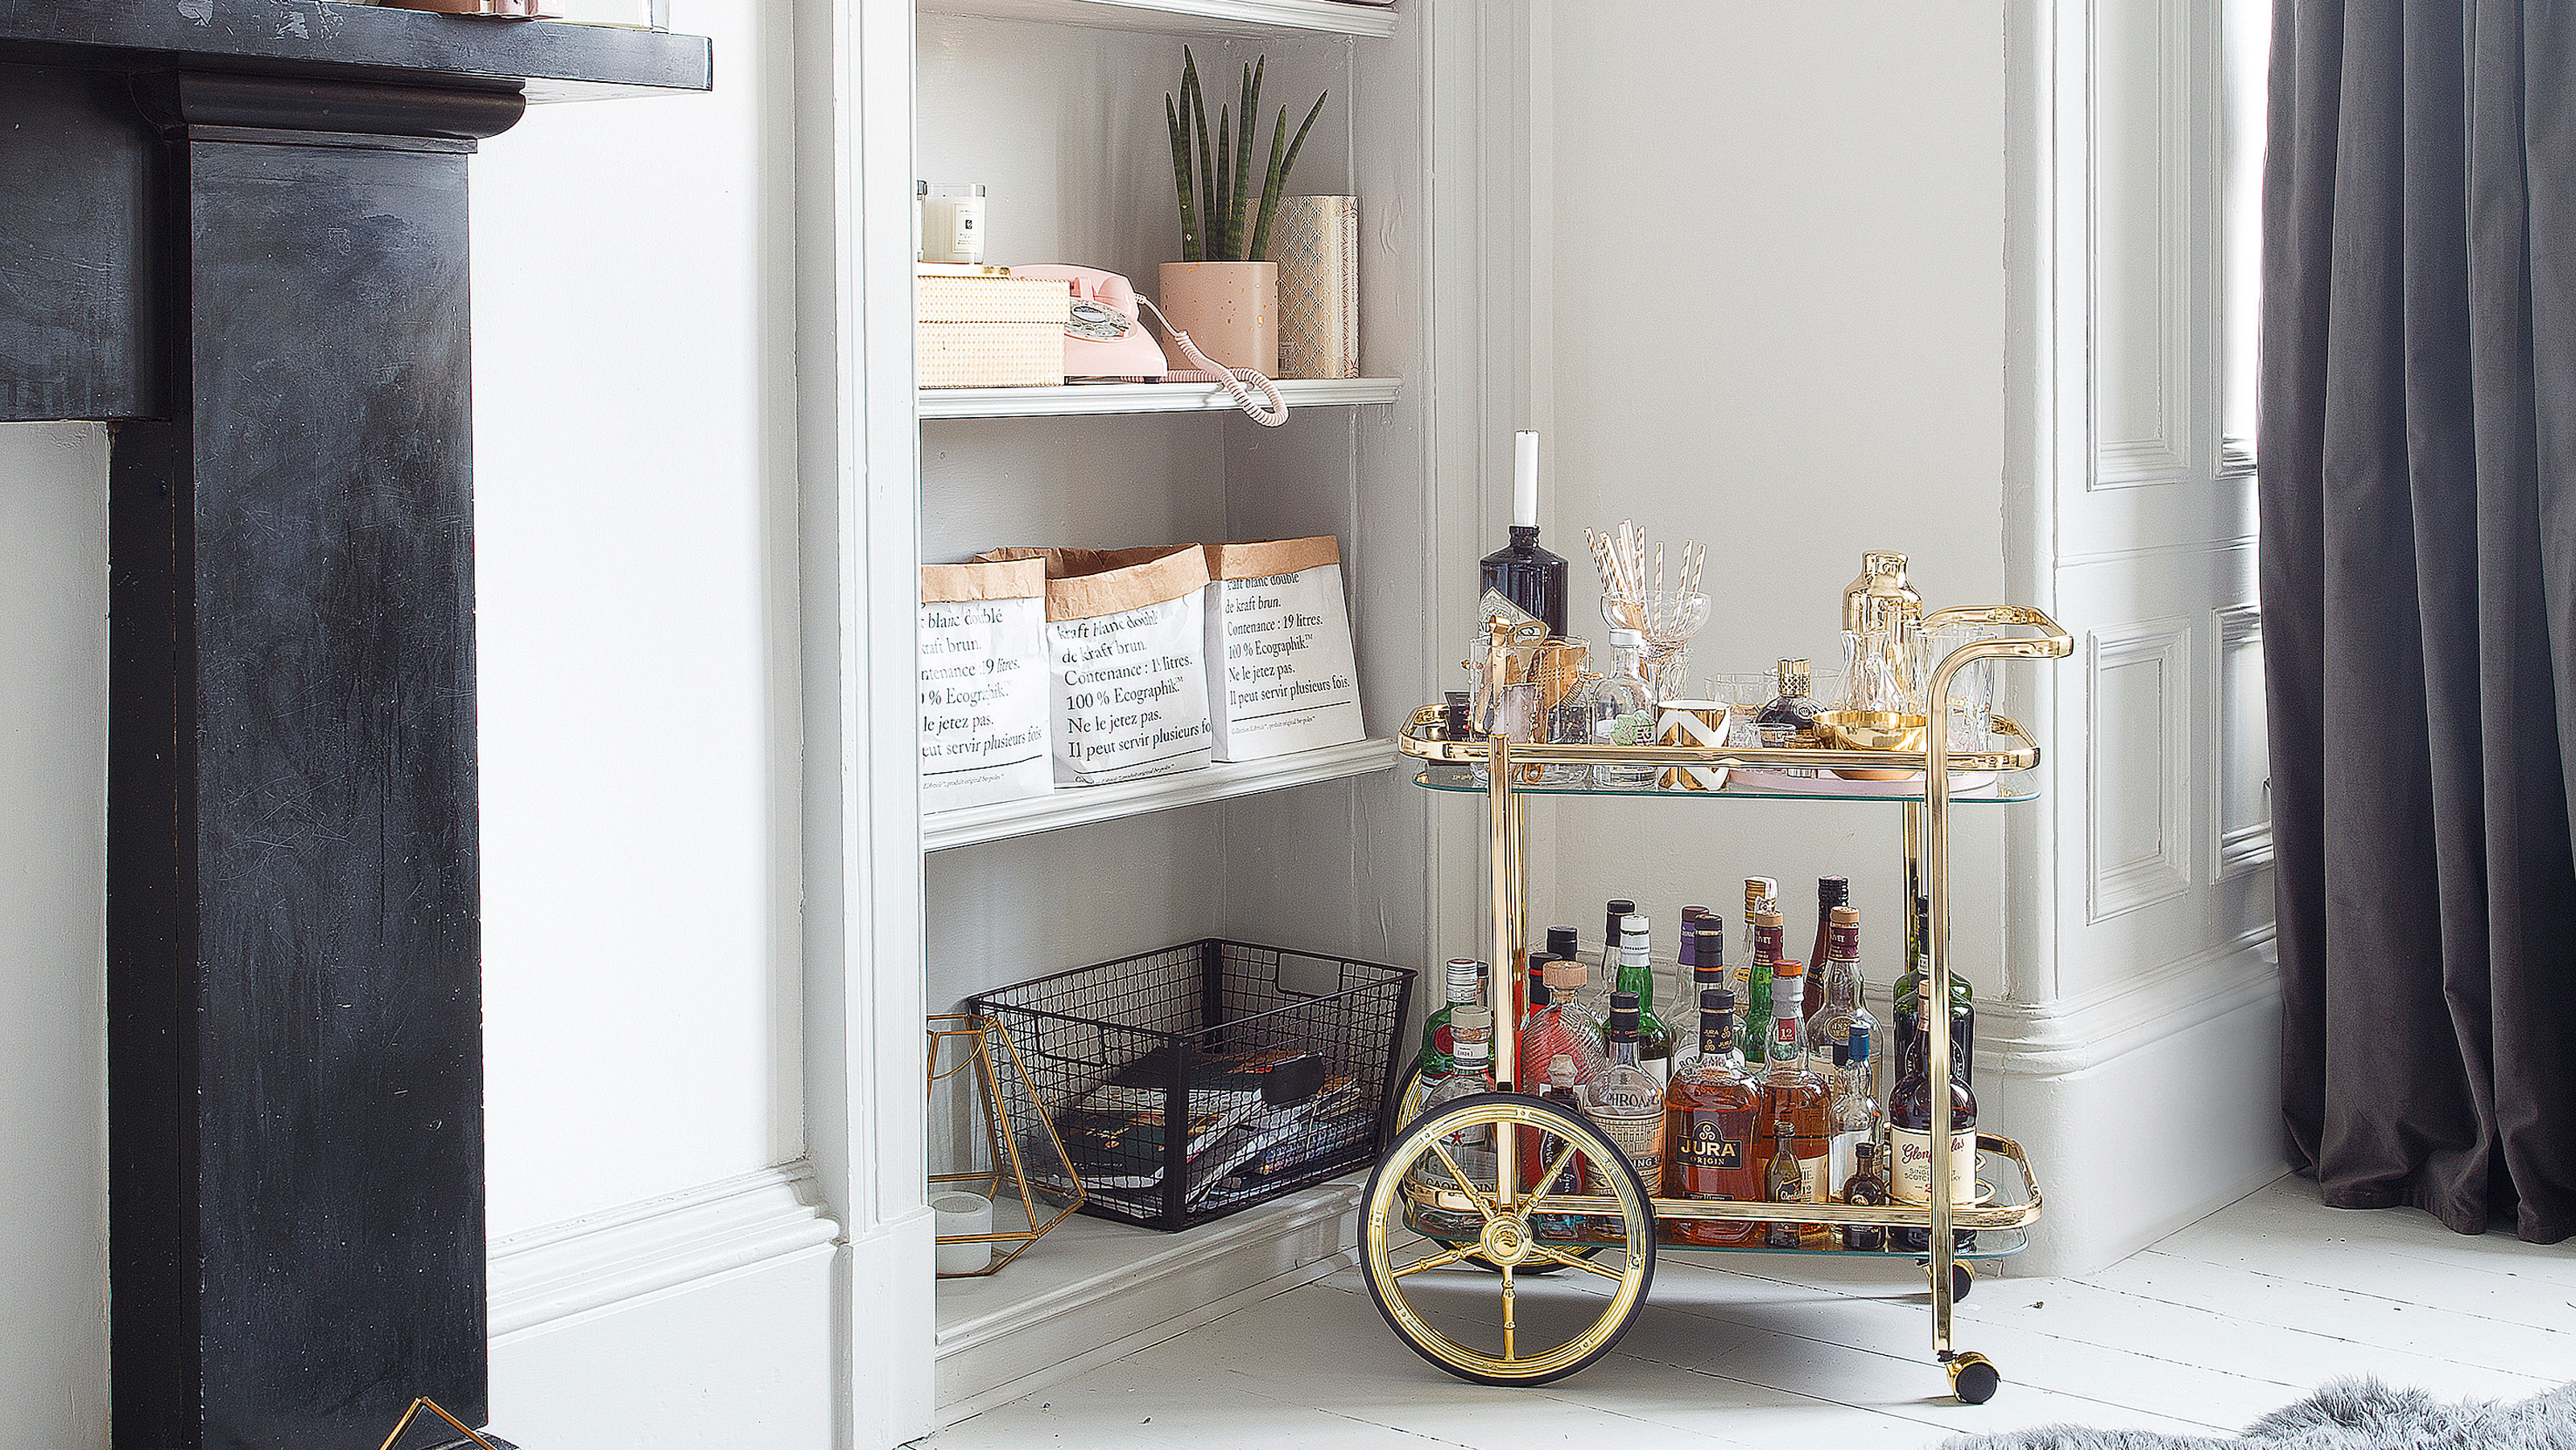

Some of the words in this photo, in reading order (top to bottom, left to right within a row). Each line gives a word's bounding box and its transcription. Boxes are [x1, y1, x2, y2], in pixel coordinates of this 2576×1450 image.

[1225, 599, 1234, 613] de
[1236, 595, 1256, 612] kraft
[1257, 595, 1282, 609] brun.
[928, 612, 960, 629] blanc
[1227, 619, 1276, 637] Contenance
[1283, 613, 1295, 630] 19
[1296, 613, 1324, 628] litres.
[946, 637, 982, 653] brun.
[1062, 648, 1078, 664] de
[1114, 639, 1148, 655] brun.
[1243, 641, 1254, 657] %
[921, 663, 976, 681] ntenance
[1064, 664, 1143, 687] Contenance
[1162, 654, 1194, 671] litres.
[1228, 666, 1241, 683] Ne
[1241, 665, 1251, 681] le
[1252, 665, 1276, 684] jetez
[1276, 662, 1296, 680] pas.
[928, 689, 943, 706] %
[1066, 692, 1094, 711] 100
[1096, 689, 1110, 707] %
[1238, 691, 1260, 709] peut
[1261, 683, 1289, 700] servir
[1290, 677, 1332, 701] plusieurs
[1331, 674, 1352, 690] fois.
[923, 715, 935, 733] le
[936, 715, 969, 737] jetez
[972, 714, 995, 733] pas.
[1067, 717, 1092, 734] Ne
[1095, 715, 1107, 732] le
[1108, 713, 1138, 735] jetez
[1140, 708, 1162, 729] pas.
[922, 744, 943, 758] eut
[946, 737, 981, 756] servir
[982, 731, 1026, 758] plusieurs
[1068, 741, 1083, 758] Il
[1086, 742, 1117, 762] peut
[1118, 731, 1150, 752] servir
[1152, 725, 1200, 750] plusieurs
[1200, 717, 1212, 735] fo
[1781, 1028, 1794, 1039] 12
[1680, 1139, 1736, 1158] JURA
[1633, 1158, 1653, 1168] ING
[1690, 1156, 1725, 1166] ORIGIN
[1802, 1185, 1812, 1195] 12
